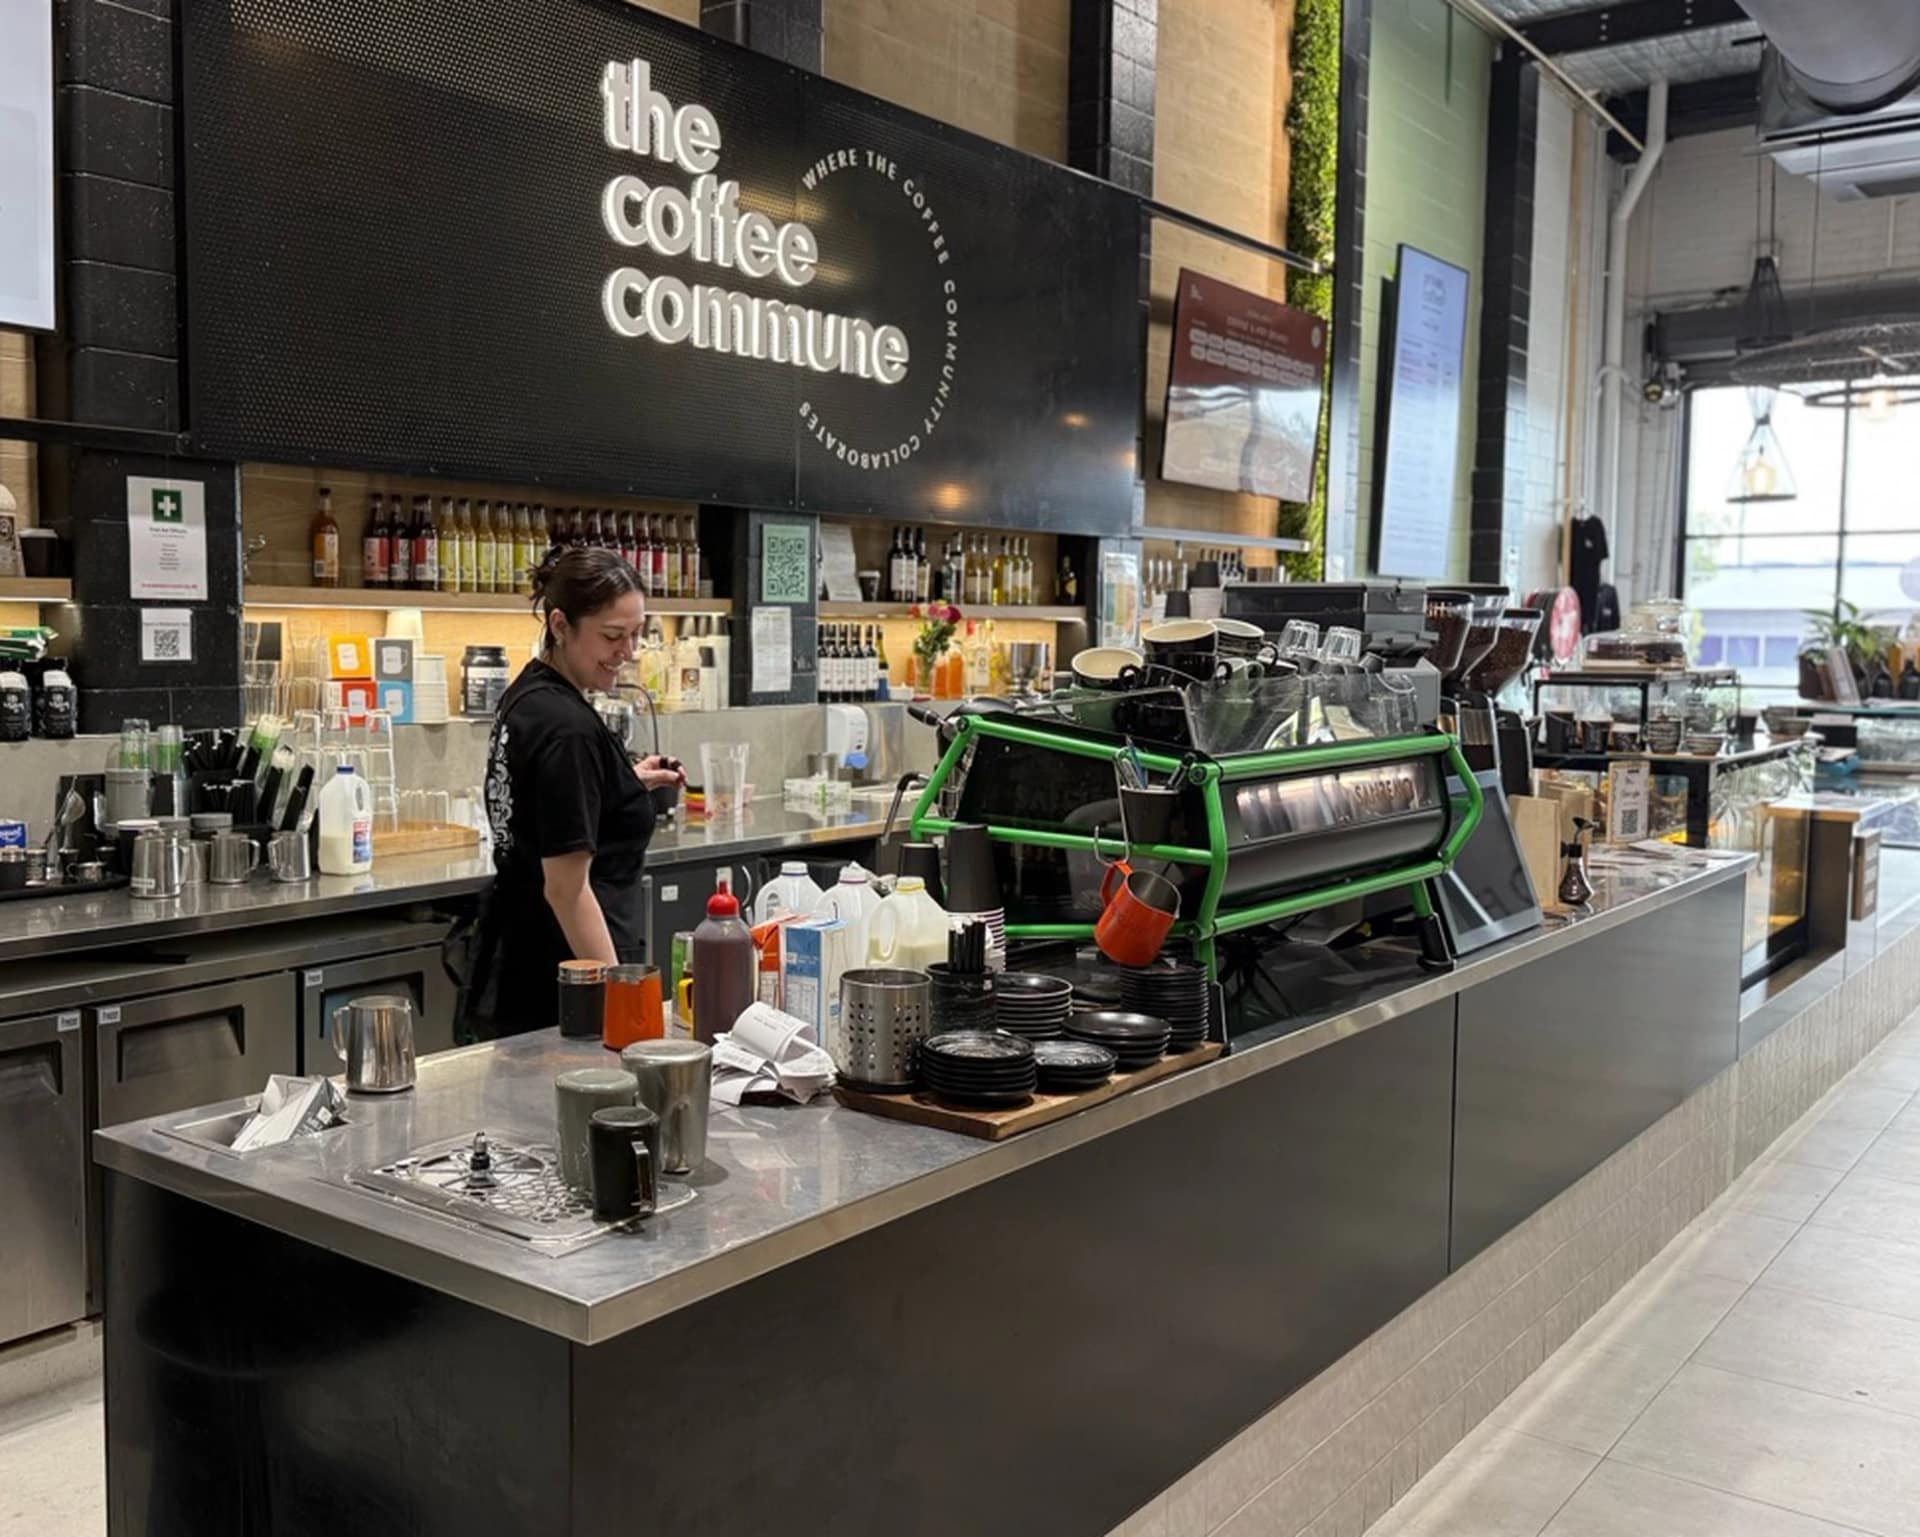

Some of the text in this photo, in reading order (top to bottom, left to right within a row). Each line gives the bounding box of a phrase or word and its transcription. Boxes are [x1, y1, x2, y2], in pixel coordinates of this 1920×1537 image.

[603, 58, 721, 173] the
[602, 174, 818, 286] coffee
[602, 267, 909, 384] commune
[799, 149, 958, 469] WHERE THE COFFEE COMMUNITY COLLABORATES
